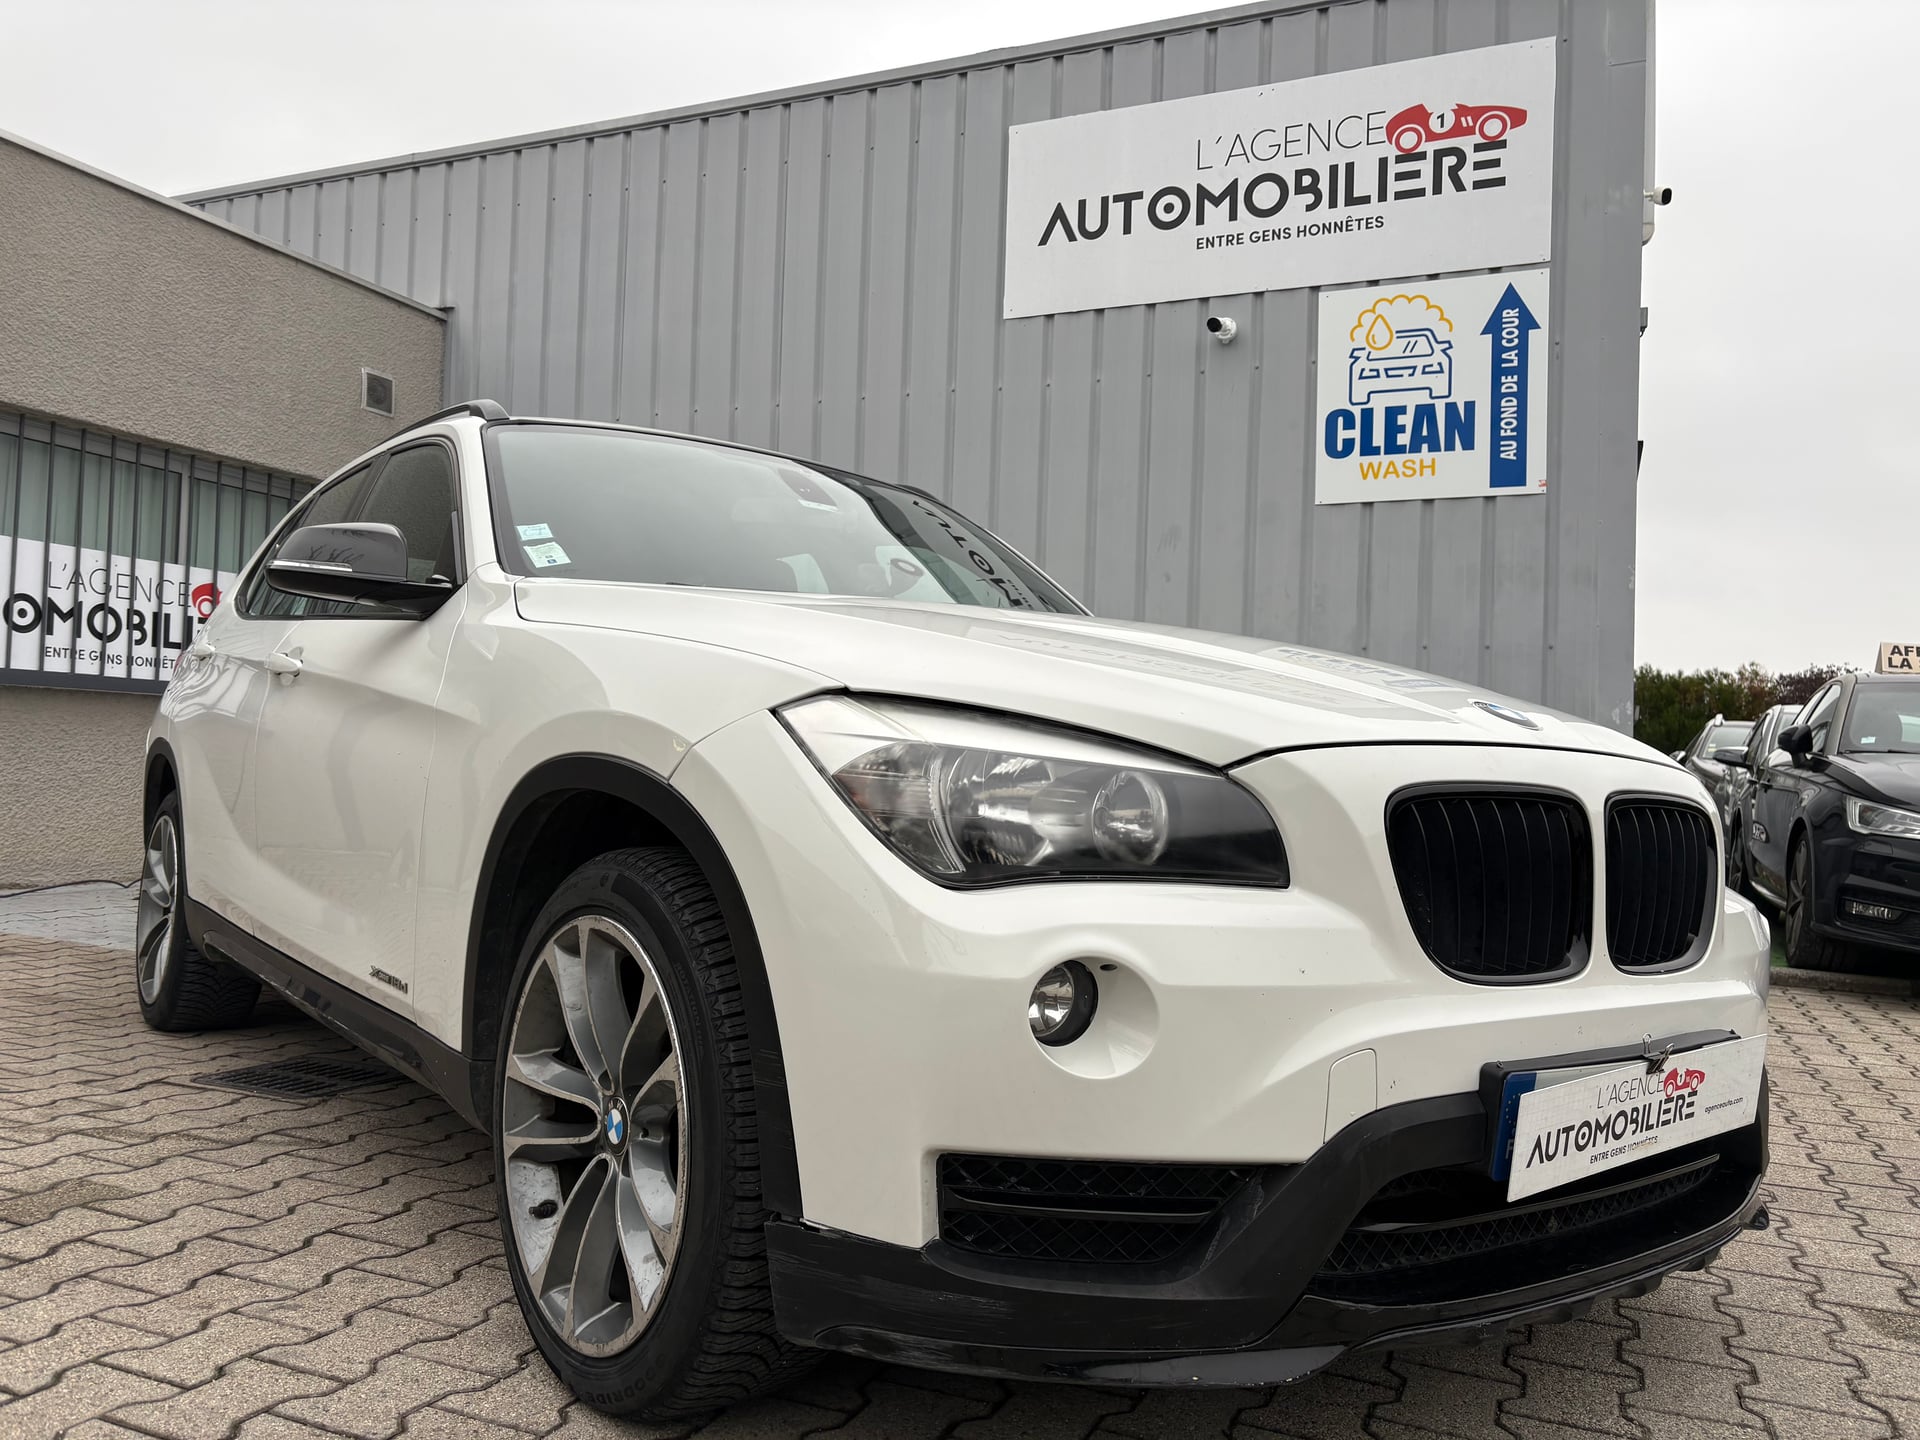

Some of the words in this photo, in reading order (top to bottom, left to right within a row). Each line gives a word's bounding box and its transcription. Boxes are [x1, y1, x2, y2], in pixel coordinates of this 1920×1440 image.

[1196, 110, 1387, 170] L'AGENCE
[1037, 139, 1508, 247] AUTOMOBILIERE
[1195, 231, 1245, 250] ENTRE
[1249, 226, 1292, 245] GENS
[1296, 215, 1385, 239] HONNÊTES
[1502, 308, 1520, 348] COUR
[1501, 350, 1519, 368] LA
[1501, 375, 1518, 393] DE
[1324, 400, 1476, 459] CLEAN
[1500, 396, 1518, 438] FOND
[1500, 441, 1518, 460] AU
[1359, 458, 1436, 481] WASH
[3, 592, 207, 650] OMOBILI
[45, 646, 85, 660] ENTE
[89, 650, 122, 665] GNS
[1888, 657, 1913, 669] LA
[1597, 1072, 1664, 1109] L'AGENCE
[1526, 1090, 1698, 1168] AUTOMOBILIERE
[1590, 1150, 1609, 1164] ENTRE
[1610, 1145, 1627, 1158] GENS
